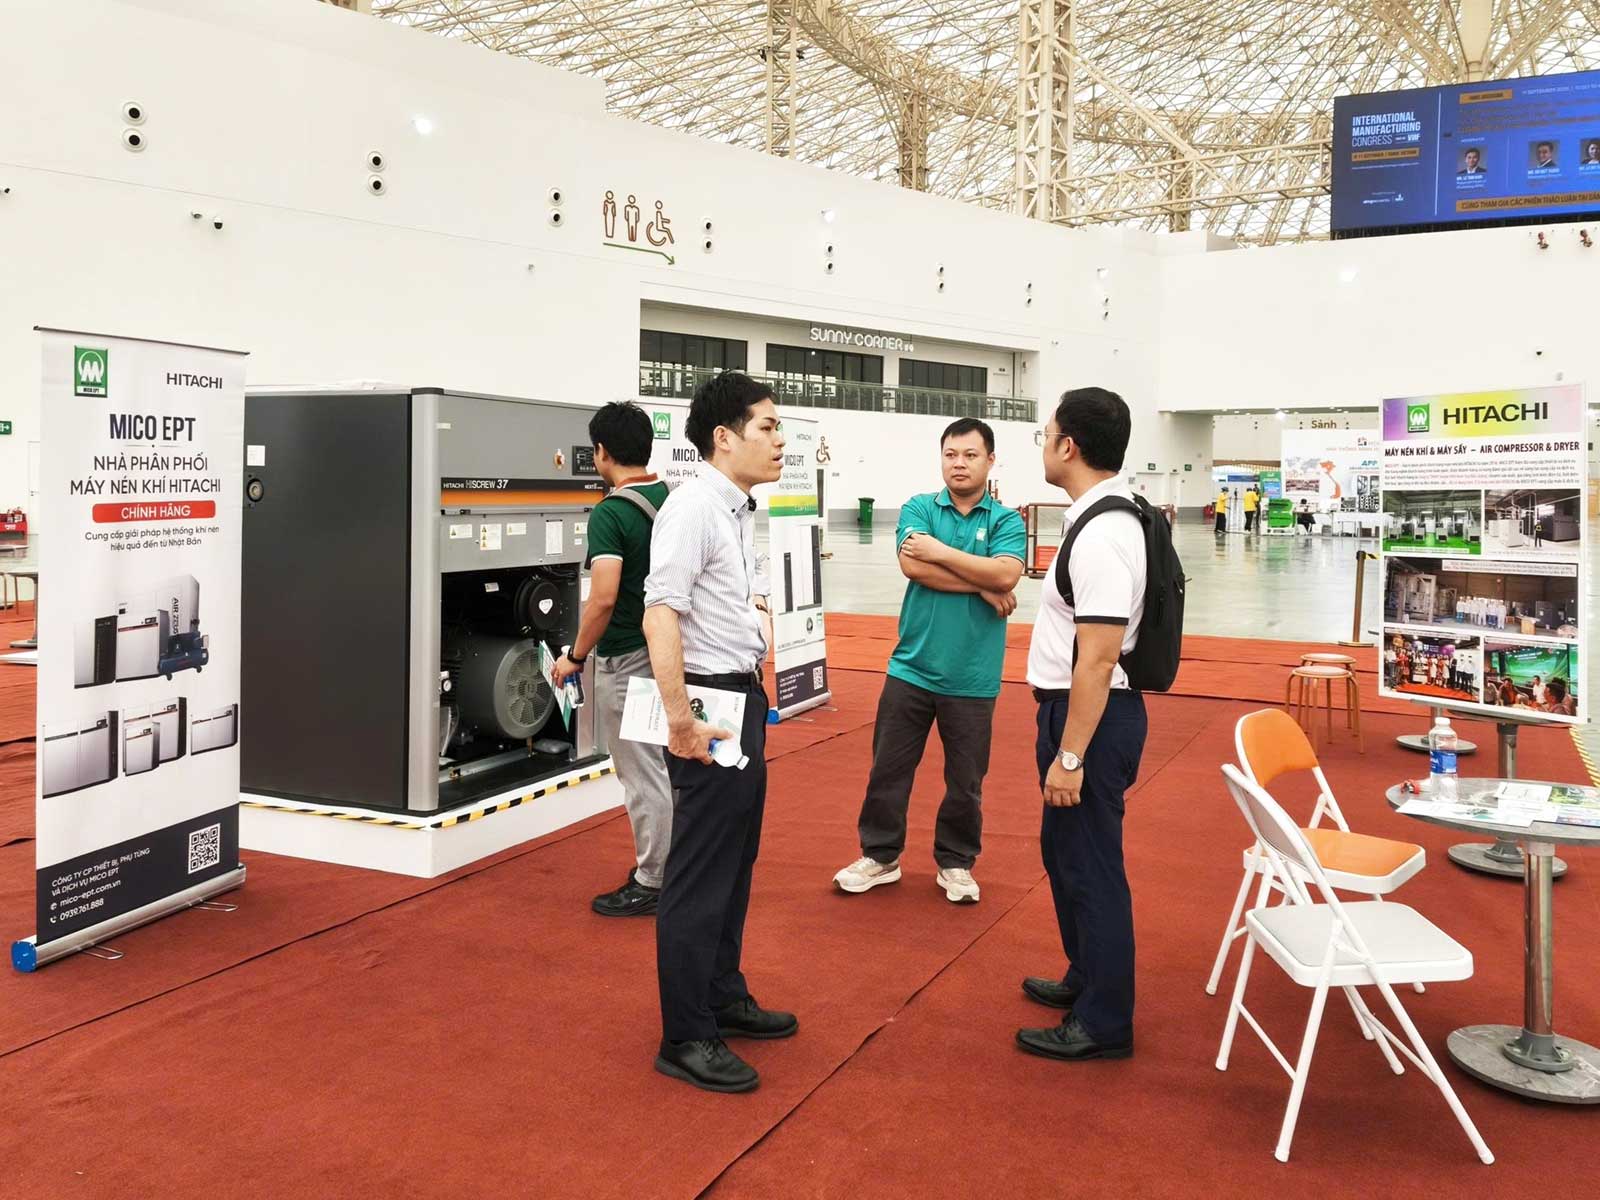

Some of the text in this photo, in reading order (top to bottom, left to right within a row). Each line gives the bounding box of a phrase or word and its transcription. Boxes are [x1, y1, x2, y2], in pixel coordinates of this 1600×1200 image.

[1352, 111, 1416, 126] INTERNATIONAL
[1352, 122, 1421, 136] MANUFACTURING
[1352, 134, 1393, 147] CONGRESS
[810, 327, 853, 345] SUNNY
[854, 333, 903, 351] CORNER
[166, 372, 223, 390] HITACHI
[1443, 402, 1548, 425] HITACHI
[109, 413, 196, 441] MICO EPT
[672, 448, 696, 462] MICO
[1384, 447, 1399, 457] MÁY
[1400, 445, 1415, 456] NÉN
[1416, 445, 1429, 456] KHÍ
[1429, 446, 1435, 455] &
[1436, 444, 1453, 455] MÁY
[1453, 443, 1467, 454] SẤY
[1480, 444, 1493, 454] AIR
[1494, 443, 1544, 453] COMPRESSOR
[1545, 442, 1552, 452] &
[1553, 441, 1580, 451] DRYER
[94, 451, 208, 471] NHÀ PHÂN PHỐI
[70, 475, 221, 495] MÁY NÉN KHÍ HITACHI
[465, 479, 496, 489] HISCREW
[496, 479, 509, 489] 37
[121, 503, 191, 519] CHÍNH HÃNG
[84, 531, 109, 542] Cung
[52, 874, 72, 887] CÔNG
[73, 871, 82, 879] TY
[83, 867, 93, 876] CP
[89, 871, 106, 883] MICO
[108, 867, 119, 877] EPT
[60, 880, 121, 907] mico-ept.com.vn
[59, 898, 104, 921] 0939.761.888
